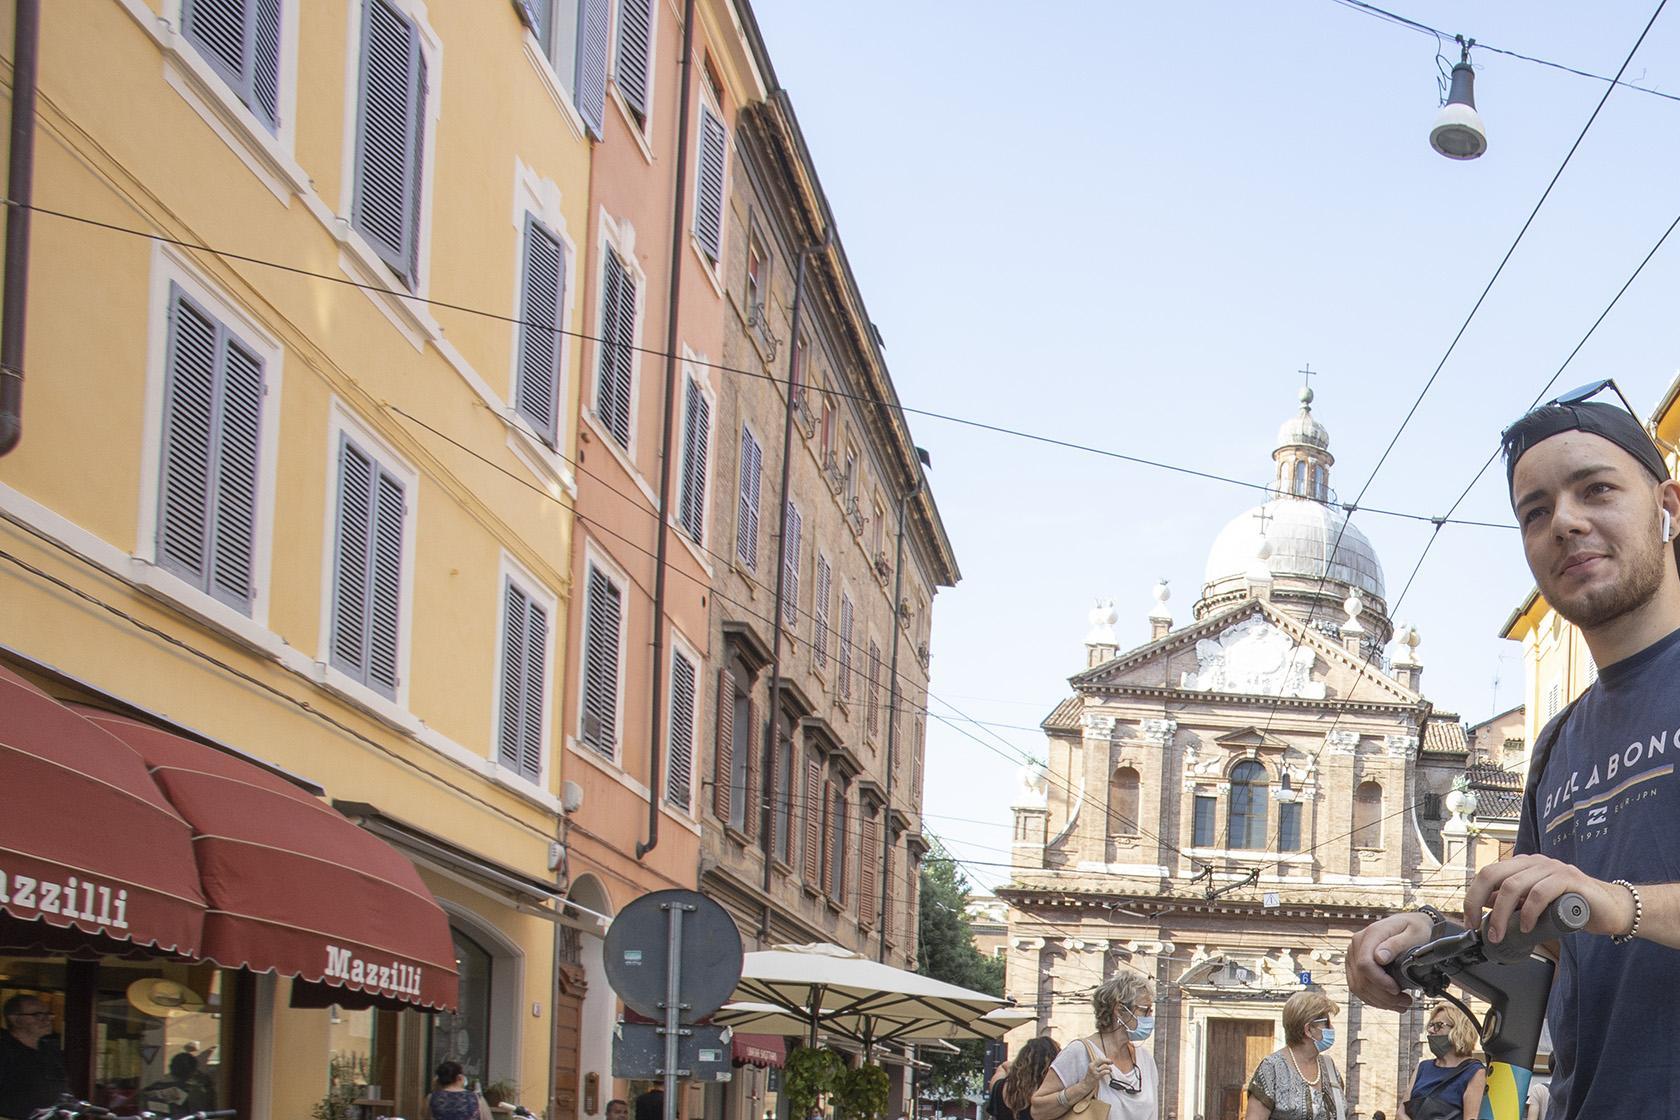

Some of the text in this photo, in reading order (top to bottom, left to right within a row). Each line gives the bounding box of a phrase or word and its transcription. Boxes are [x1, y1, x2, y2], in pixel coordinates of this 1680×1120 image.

[1580, 827, 1608, 842] 1973
[324, 945, 423, 995] Mazzilli
[1302, 973, 1309, 984] 6
